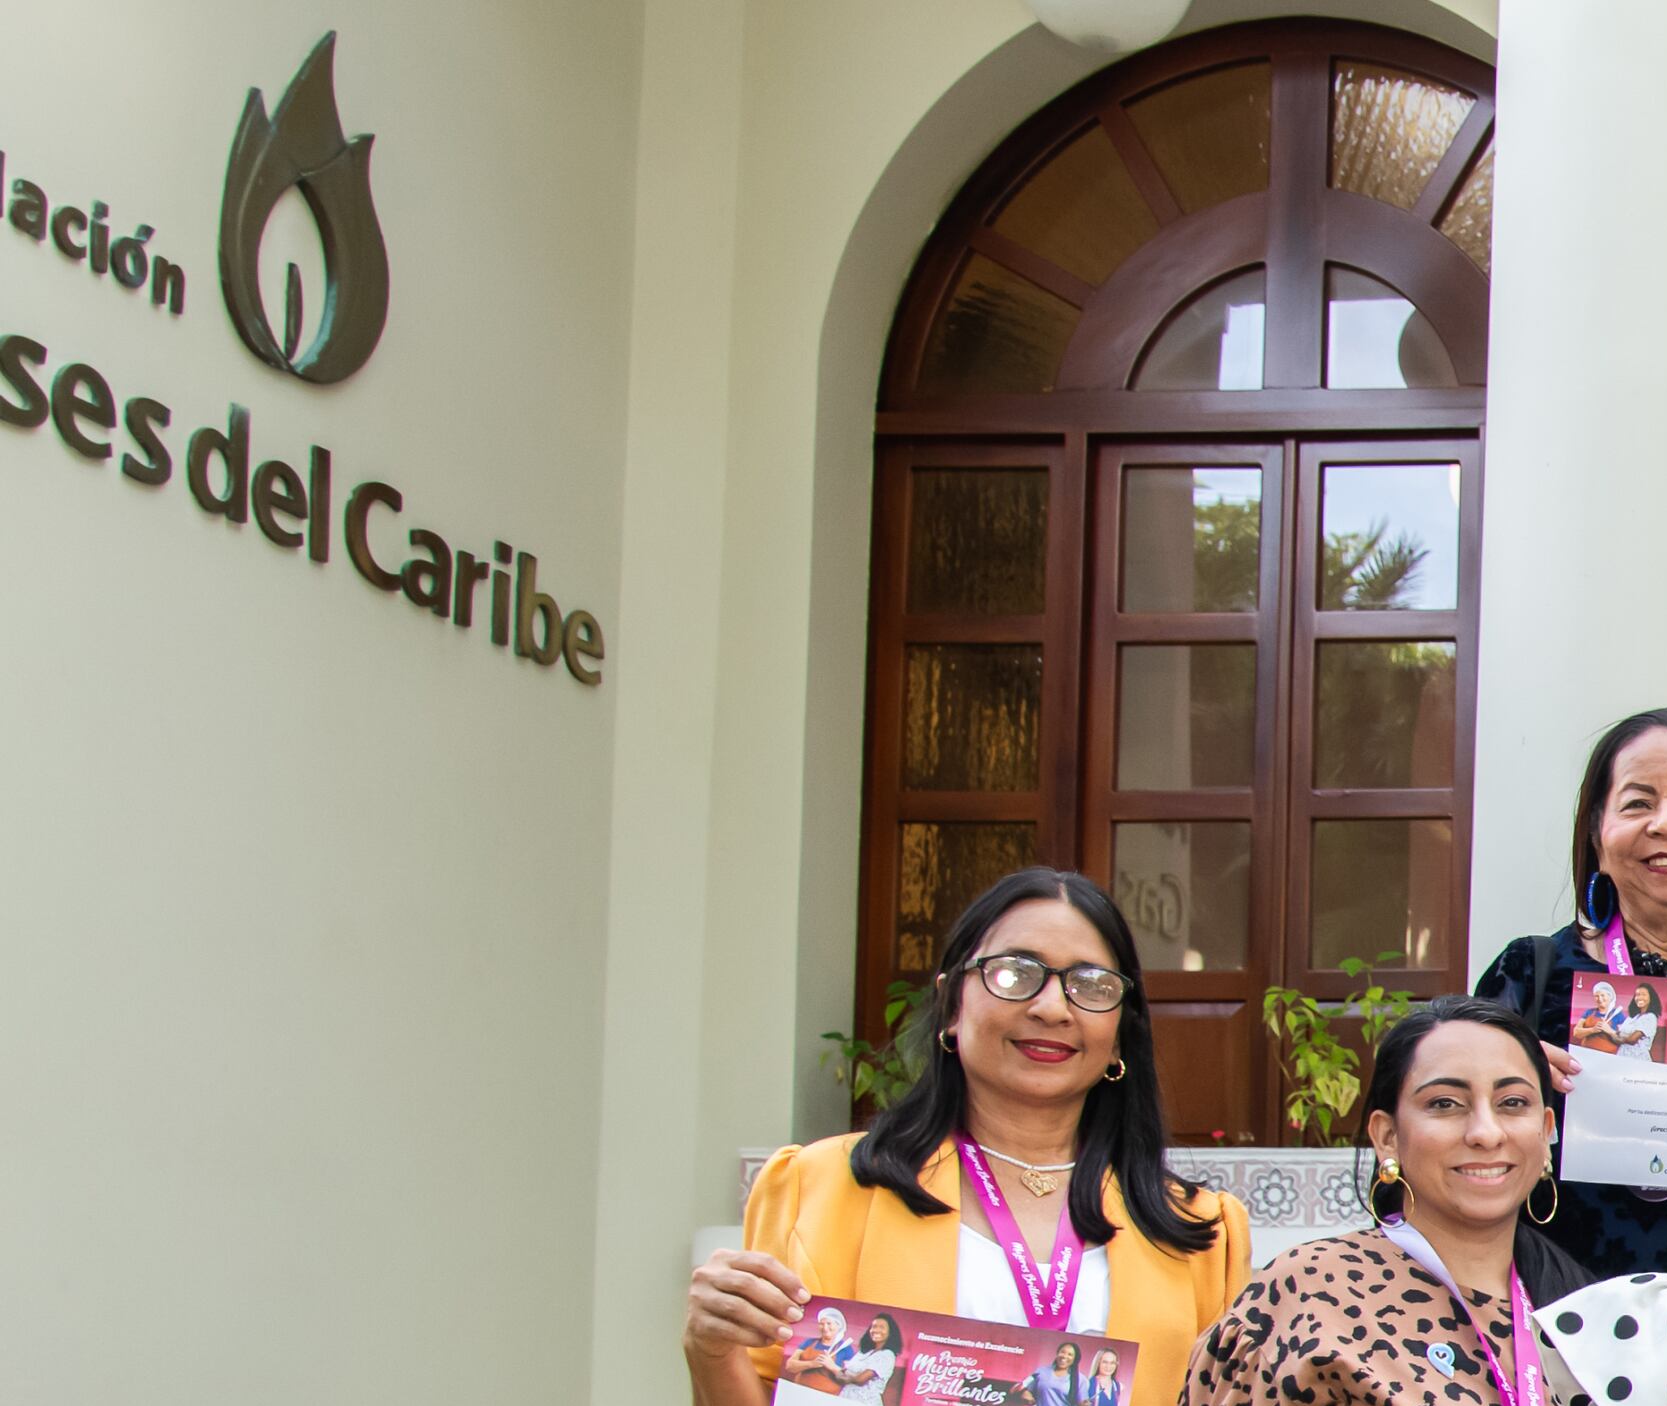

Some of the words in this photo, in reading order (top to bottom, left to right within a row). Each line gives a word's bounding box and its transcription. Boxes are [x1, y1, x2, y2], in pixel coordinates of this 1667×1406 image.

[0, 150, 187, 316] ación
[186, 402, 332, 565] del
[344, 480, 606, 687] Caribe
[911, 1353, 985, 1383] Mujeres
[939, 1350, 978, 1367] Premio
[914, 1374, 1007, 1405] Brillantes
